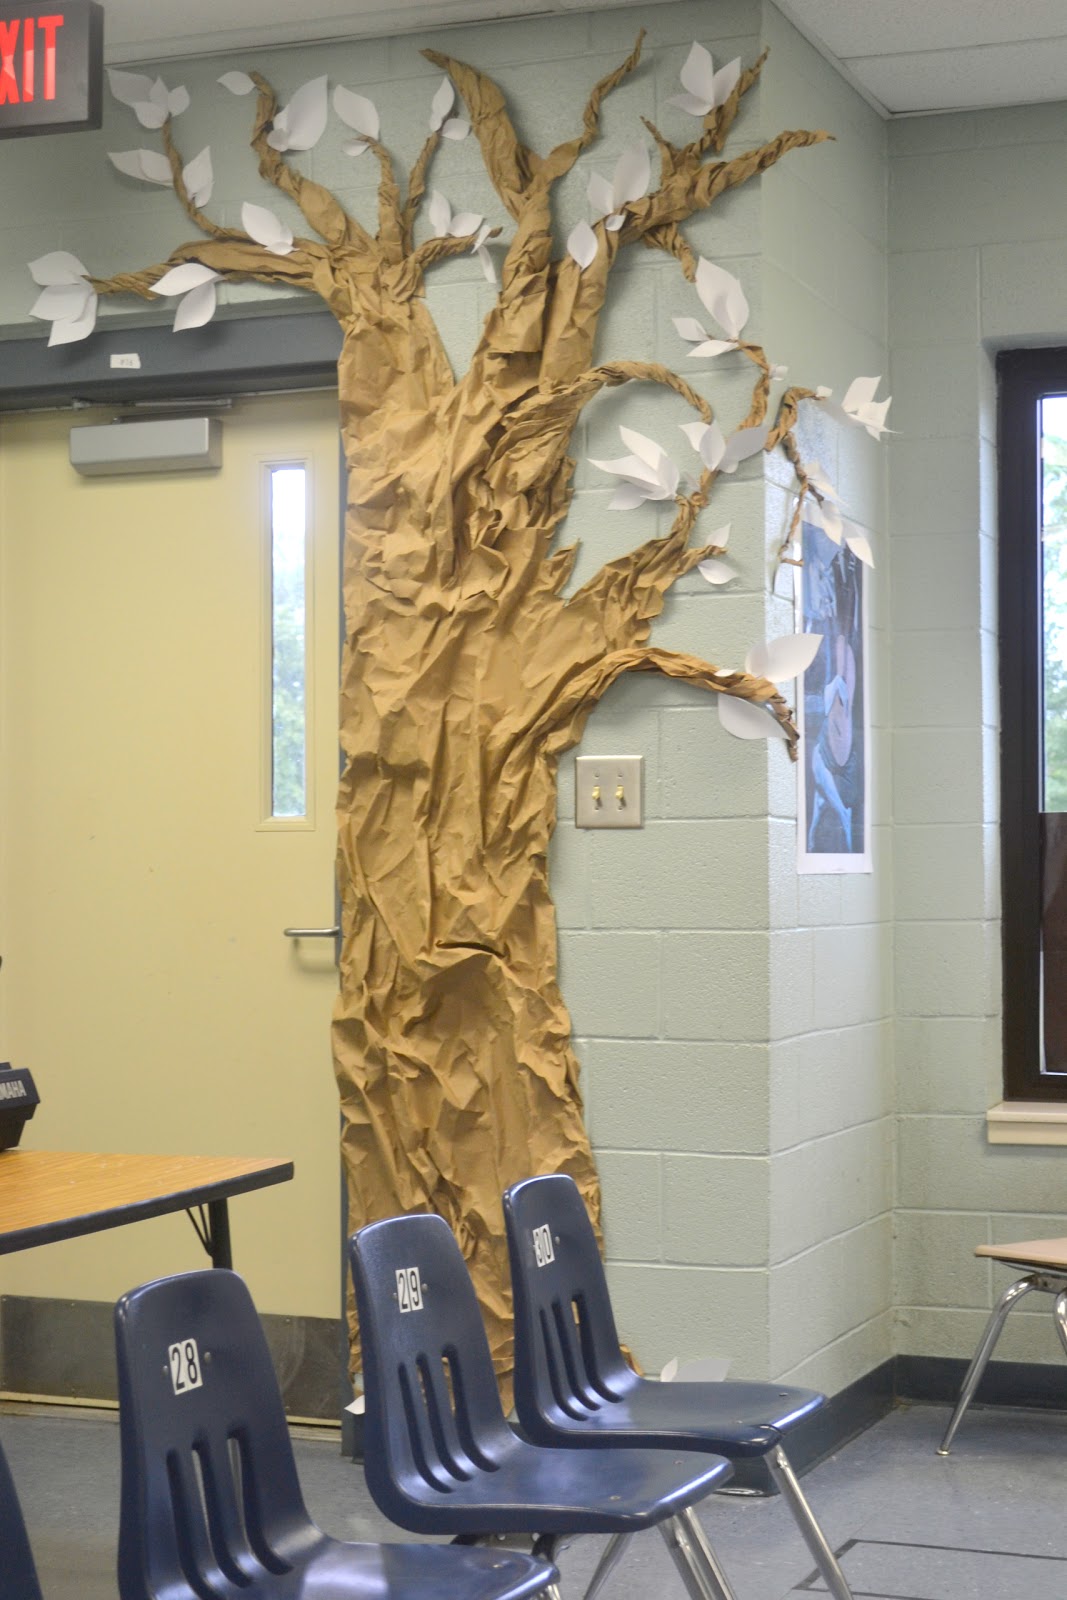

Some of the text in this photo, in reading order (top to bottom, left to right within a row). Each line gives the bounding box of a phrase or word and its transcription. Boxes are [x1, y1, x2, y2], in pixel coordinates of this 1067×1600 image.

[0, 14, 64, 106] XIT
[0, 1080, 27, 1100] MAHA
[534, 1227, 552, 1264] 30
[398, 1270, 420, 1310] 29
[171, 1341, 198, 1391] 28
